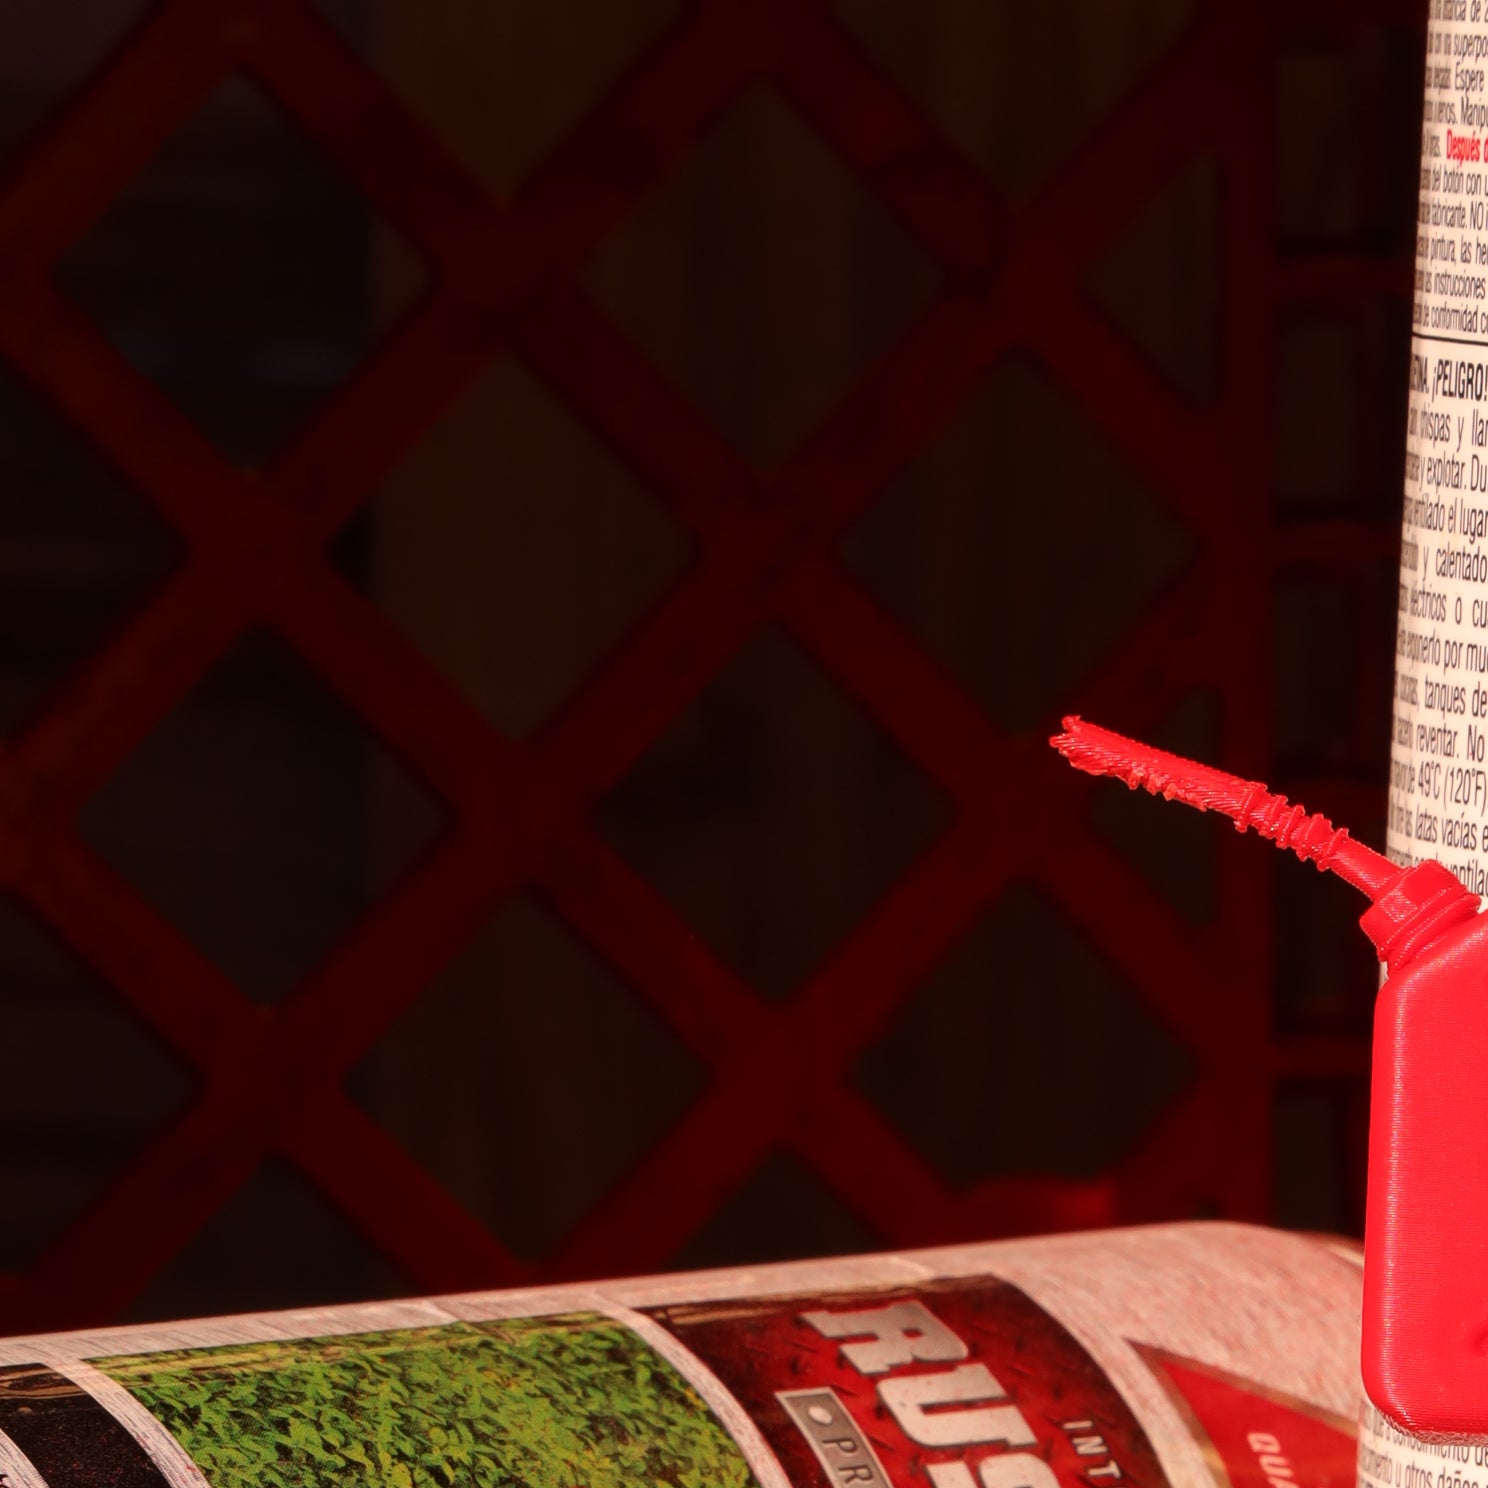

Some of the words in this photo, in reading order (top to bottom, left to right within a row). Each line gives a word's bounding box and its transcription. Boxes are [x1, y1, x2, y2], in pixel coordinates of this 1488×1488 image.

[1455, 61, 1484, 95] Espere
[1446, 129, 1480, 167] Después
[1432, 358, 1488, 402] ¡PELIGRO!
[1443, 637, 1463, 676] por
[1424, 671, 1466, 721] tanques
[1472, 681, 1487, 719] de
[1416, 720, 1460, 760] reventar.
[1467, 724, 1485, 764] No
[1415, 804, 1437, 847] latas
[1442, 811, 1477, 851] vacías
